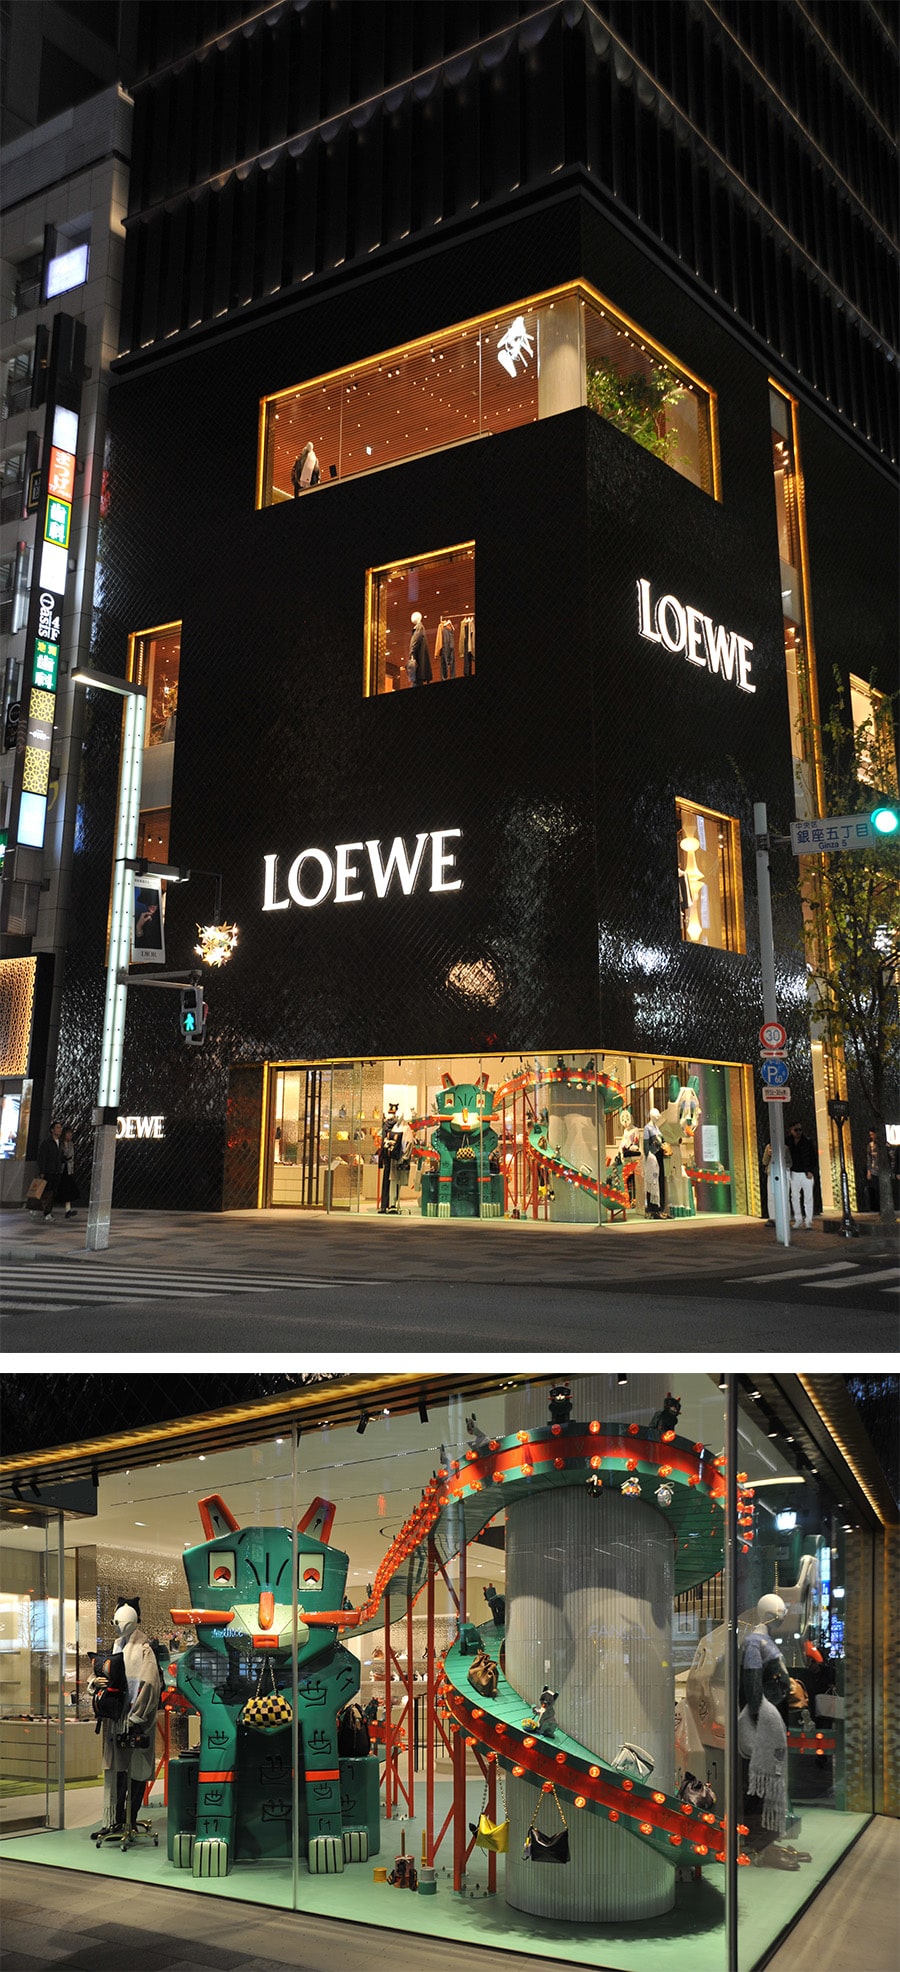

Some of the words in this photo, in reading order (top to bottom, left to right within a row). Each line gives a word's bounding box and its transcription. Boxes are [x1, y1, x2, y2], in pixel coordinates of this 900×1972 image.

[636, 578, 756, 693] LOEWE
[796, 821, 818, 829] 中央区
[797, 823, 868, 844] 銀座五丁目
[818, 841, 839, 850] Ginza
[261, 828, 464, 912] LOEWE
[765, 1029, 780, 1042] 30
[767, 1066, 778, 1083] P
[115, 1116, 165, 1139] OEWE
